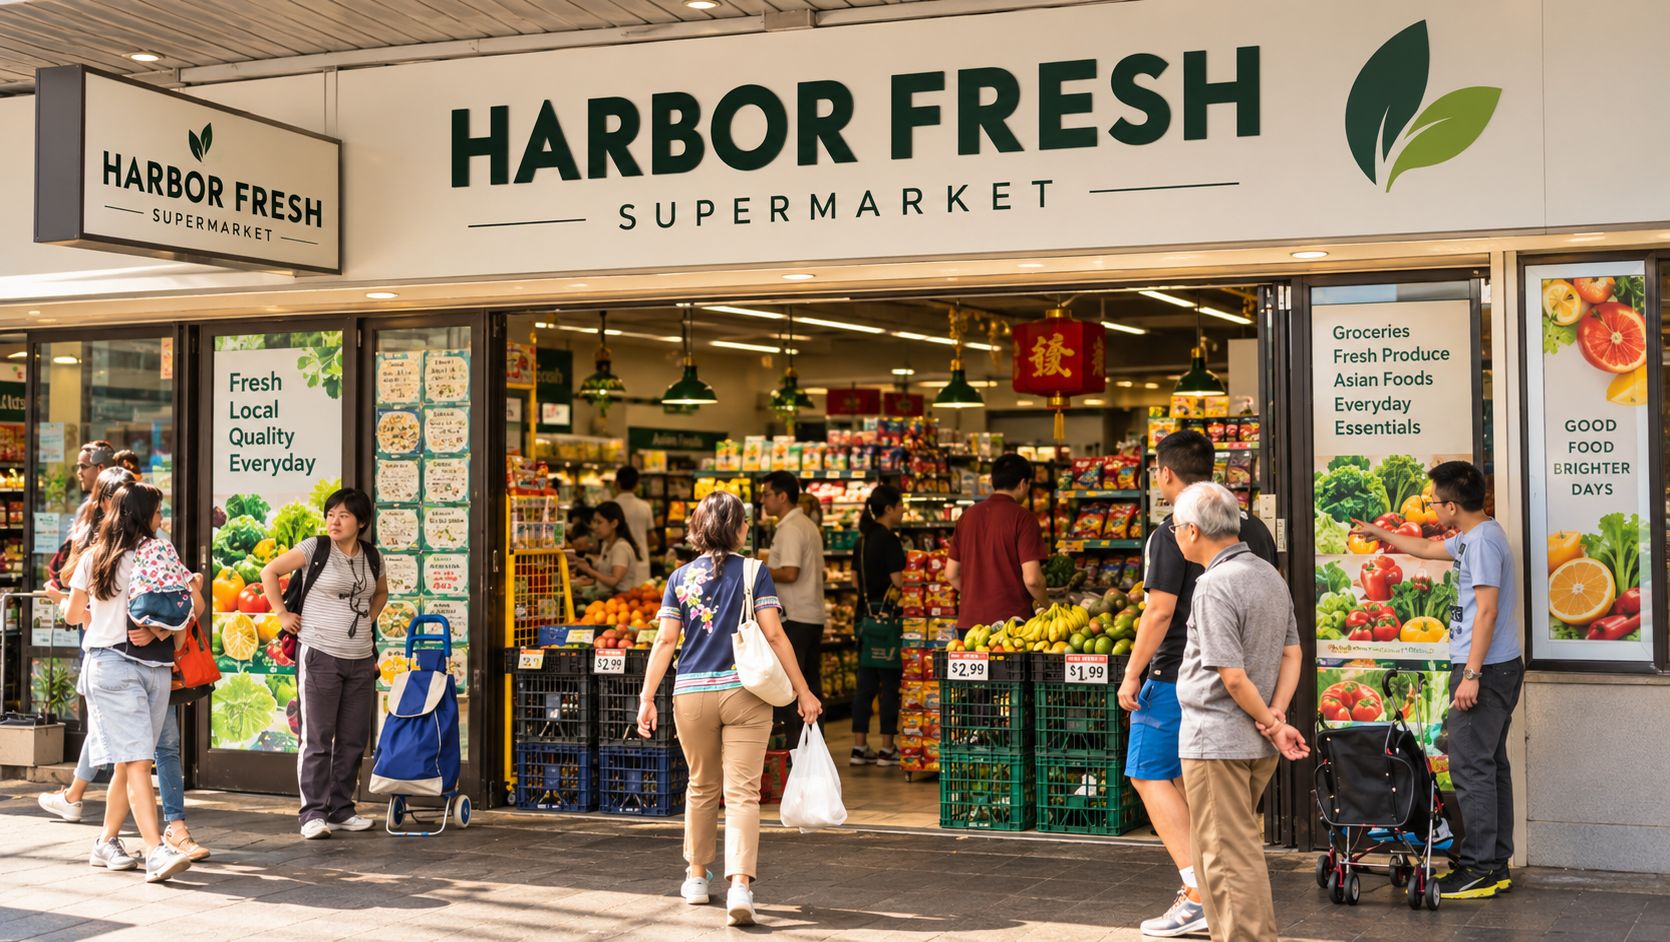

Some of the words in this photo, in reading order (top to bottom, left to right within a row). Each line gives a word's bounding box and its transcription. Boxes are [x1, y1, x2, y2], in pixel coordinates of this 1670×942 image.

[451, 79, 858, 188] HARBOR
[890, 45, 1261, 160] FRESH
[103, 150, 224, 208] HARBOR
[235, 181, 322, 228] FRESH
[618, 179, 1053, 230] SUPERMARKET
[152, 208, 273, 242] SUPERMARKET
[1332, 323, 1410, 340] Groceries
[1333, 347, 1378, 364] Fresh
[1382, 346, 1451, 363] Produce
[229, 370, 282, 393] Fresh
[1333, 372, 1379, 388] Asian
[1383, 370, 1434, 387] Foods
[229, 399, 279, 420] Local
[1334, 395, 1412, 416] Everyday
[1335, 418, 1422, 436] Essentials
[1564, 418, 1617, 433] GOOD
[228, 426, 295, 450] Quality
[1568, 440, 1615, 454] FOOD
[229, 452, 317, 477] Everyday
[1553, 462, 1631, 475] BRIGHTER
[1571, 482, 1614, 496] DAYS
